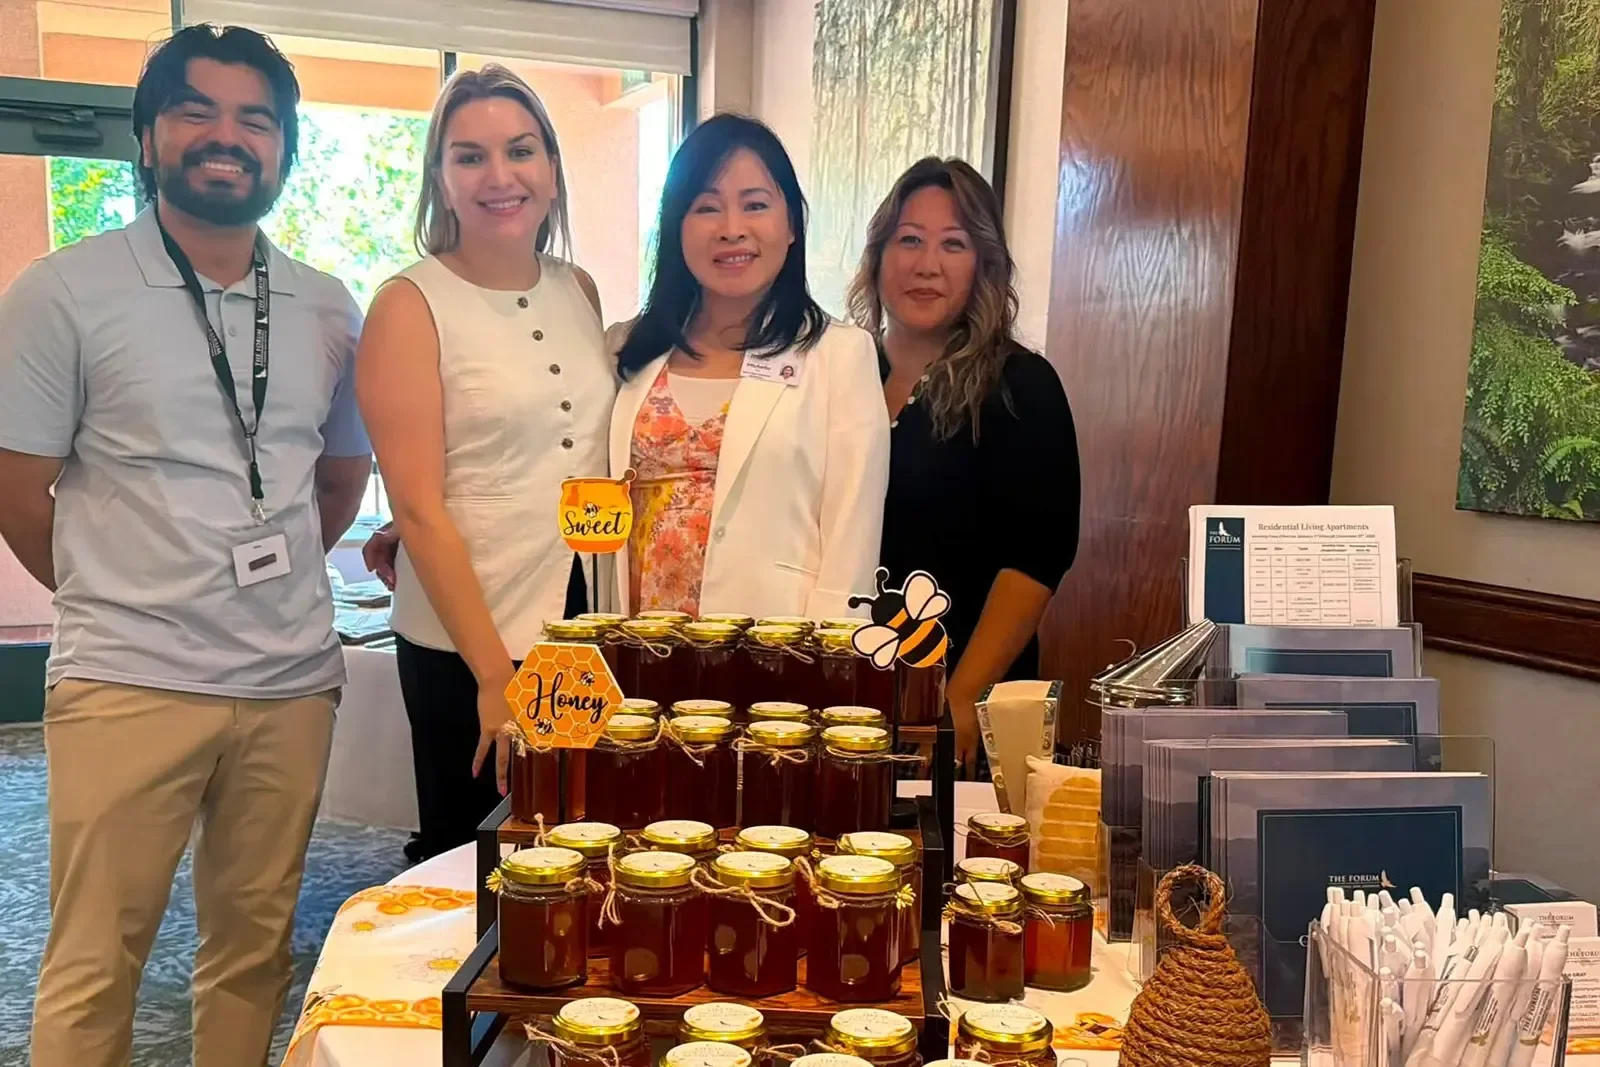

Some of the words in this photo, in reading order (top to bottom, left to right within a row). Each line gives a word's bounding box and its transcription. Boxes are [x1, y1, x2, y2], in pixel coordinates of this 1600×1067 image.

[563, 510, 630, 536] Sweet
[1258, 523, 1299, 531] Residential
[1301, 523, 1324, 532] Living
[1326, 523, 1369, 532] Apartments
[1209, 536, 1241, 544] FORUM
[526, 671, 608, 724] Honey
[1348, 874, 1380, 882] FORUM
